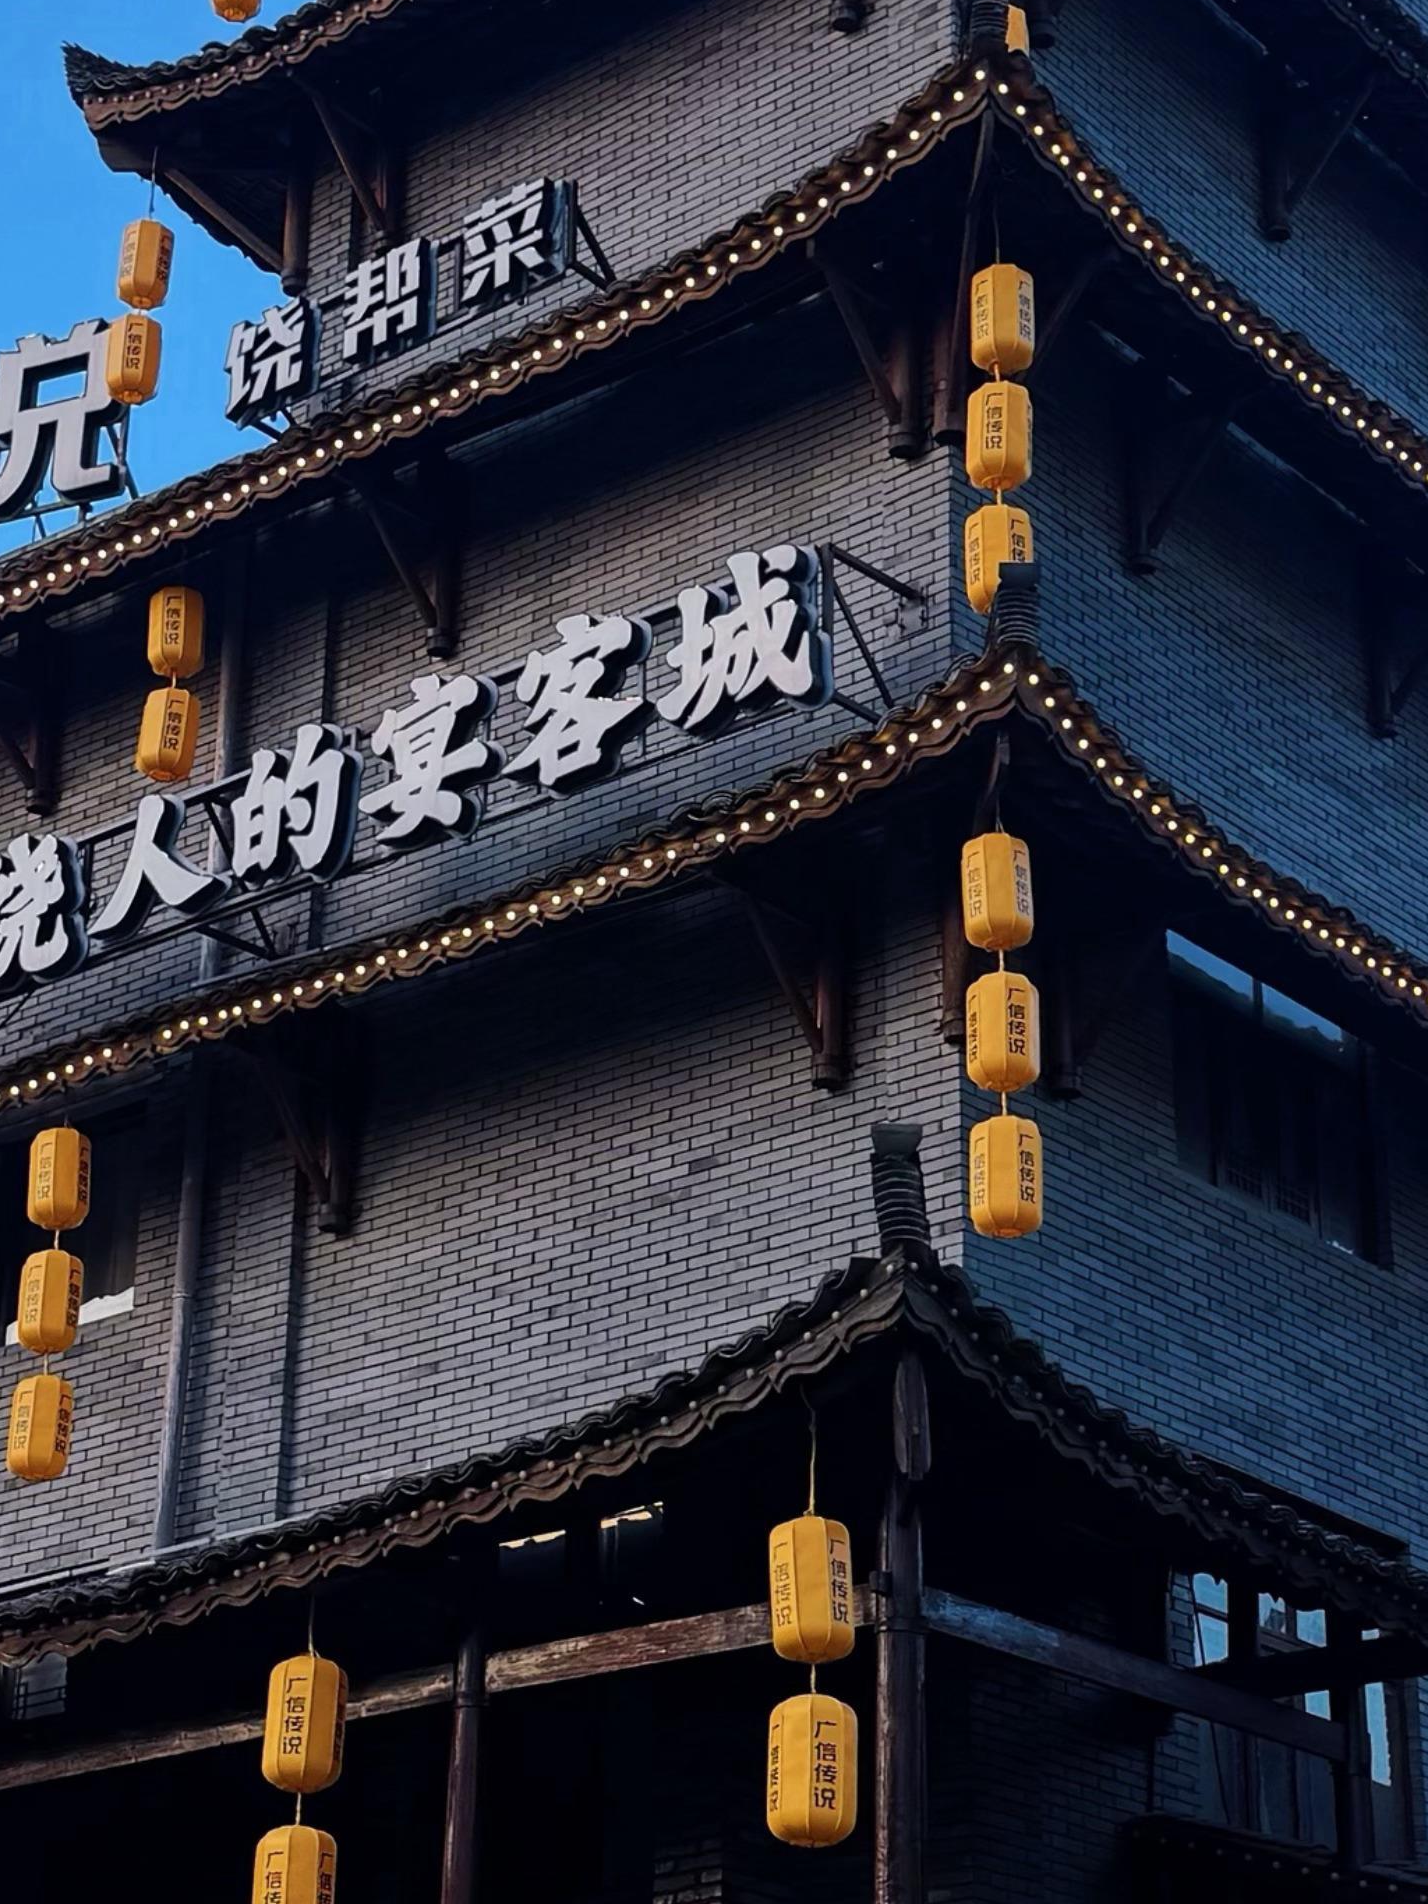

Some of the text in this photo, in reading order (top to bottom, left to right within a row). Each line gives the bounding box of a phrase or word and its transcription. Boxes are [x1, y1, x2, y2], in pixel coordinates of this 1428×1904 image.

[225, 177, 552, 416] 饶帮菜
[283, 1676, 308, 1756] 广信传说
[813, 1719, 838, 1811] 广信传说
